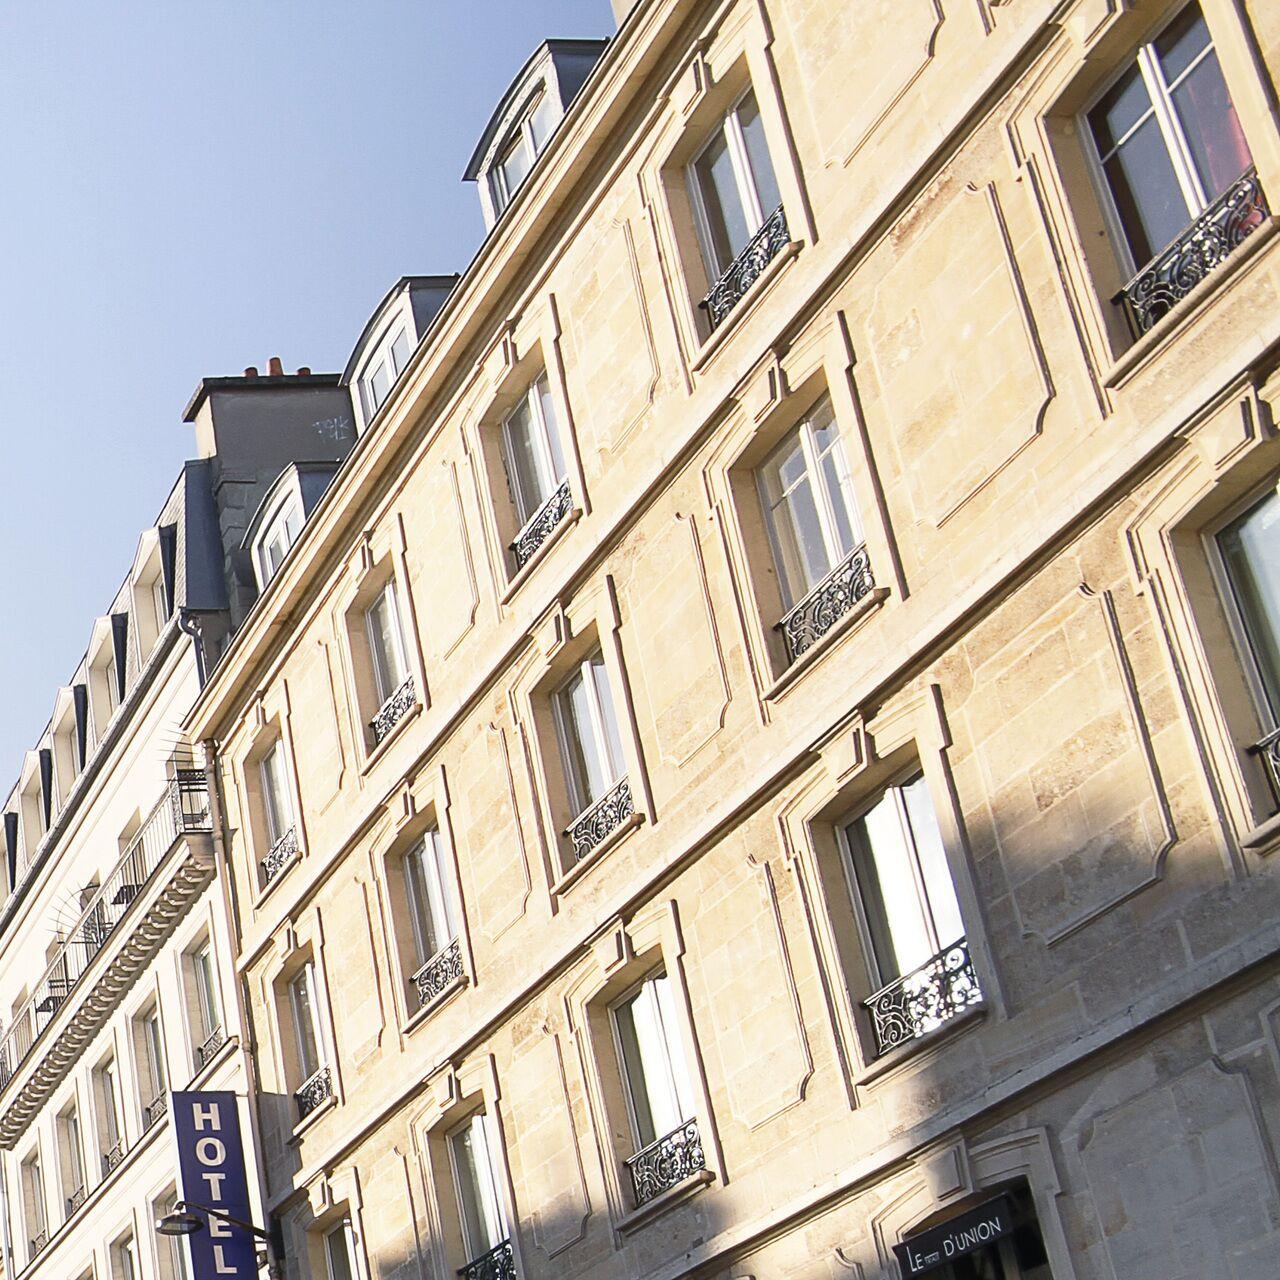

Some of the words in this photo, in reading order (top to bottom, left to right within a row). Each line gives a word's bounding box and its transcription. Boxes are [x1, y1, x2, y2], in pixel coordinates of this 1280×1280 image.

[192, 1103, 237, 1274] HOTEL
[906, 1246, 924, 1272] LE
[943, 1217, 1001, 1256] D'UNION
